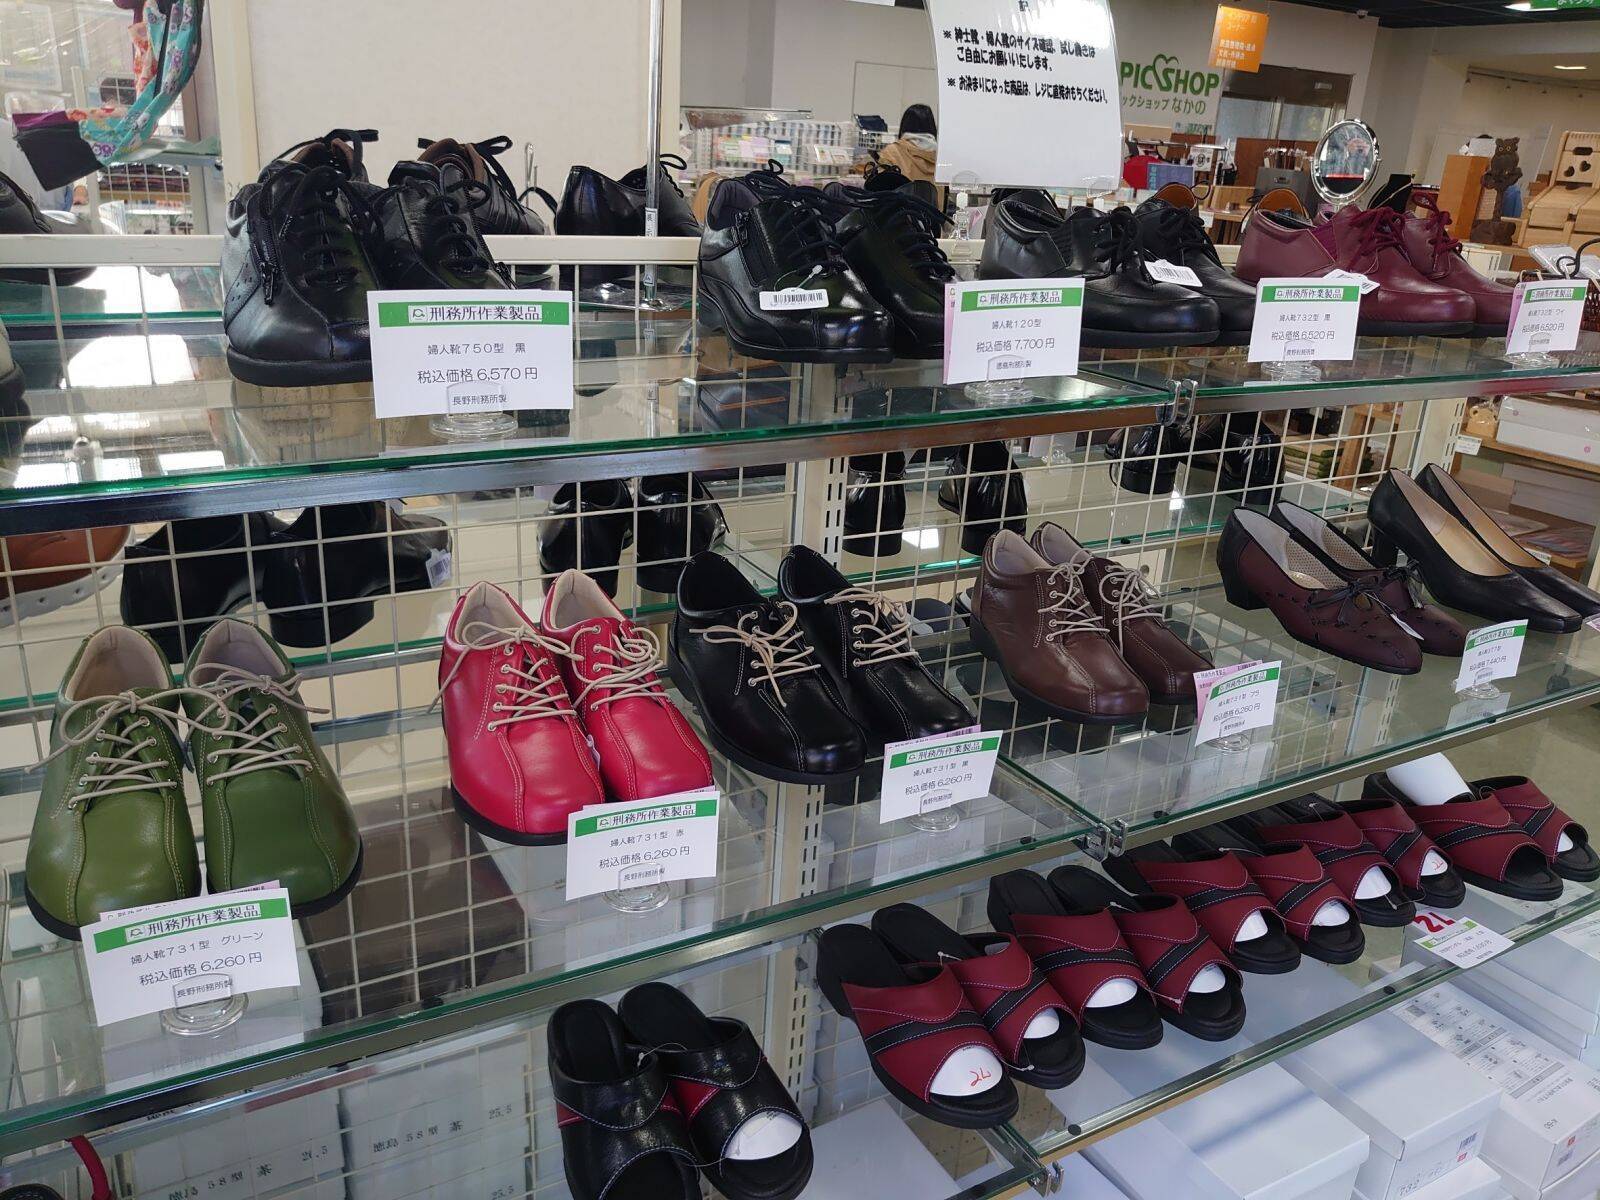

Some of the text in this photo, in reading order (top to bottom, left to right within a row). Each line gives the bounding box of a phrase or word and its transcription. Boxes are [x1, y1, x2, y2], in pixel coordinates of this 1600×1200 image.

[990, 291, 1060, 305] 刑務所作業製品
[429, 306, 540, 321] 刑務所作業製品
[992, 319, 1041, 330] 婦人靴120型
[428, 343, 526, 355] 婦人靴750型 黒
[453, 394, 507, 406] 長野刑務所製
[918, 742, 980, 761] 刑務所作業製品
[612, 805, 695, 826] 刑務所作業製品
[610, 832, 668, 848] 婦人靴731型
[149, 905, 260, 935] 刑務所作業製品
[131, 931, 263, 966] 婦人靴731型 グリーン
[176, 979, 233, 998] 長野刑務所製
